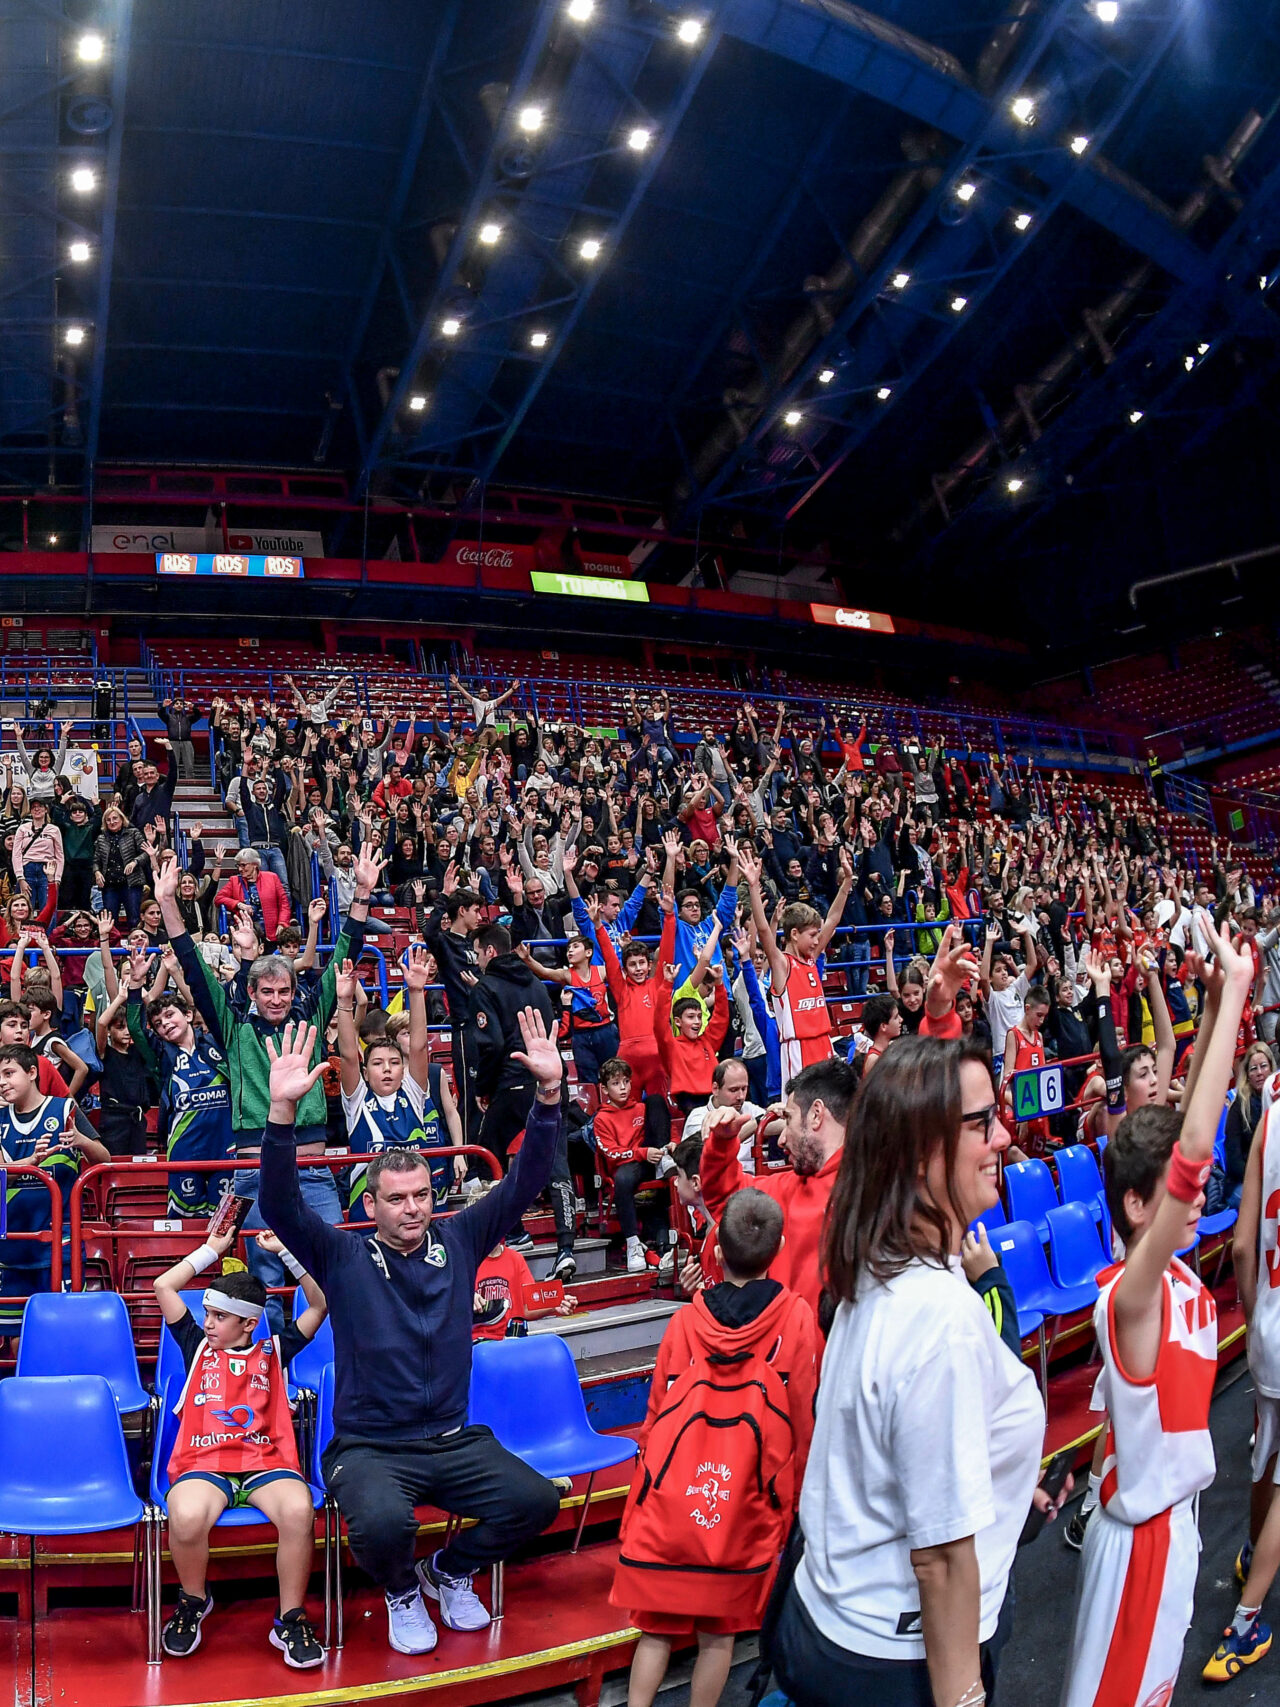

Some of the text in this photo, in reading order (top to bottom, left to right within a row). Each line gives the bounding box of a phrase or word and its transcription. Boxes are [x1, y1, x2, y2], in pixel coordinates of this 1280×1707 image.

[112, 532, 175, 550] enel
[255, 537, 304, 551] YouTube
[163, 554, 187, 571] RDS
[215, 556, 239, 572] RDS
[267, 558, 291, 574] RDS
[584, 562, 623, 574] TOGRILL
[364, 721, 370, 730] 6
[808, 973, 817, 987] 5
[191, 1089, 227, 1103] COMAP
[1021, 1076, 1057, 1110] A 6
[164, 1222, 172, 1233] 5
[543, 1290, 557, 1299] EA7
[696, 1462, 732, 1481] AVALLINO
